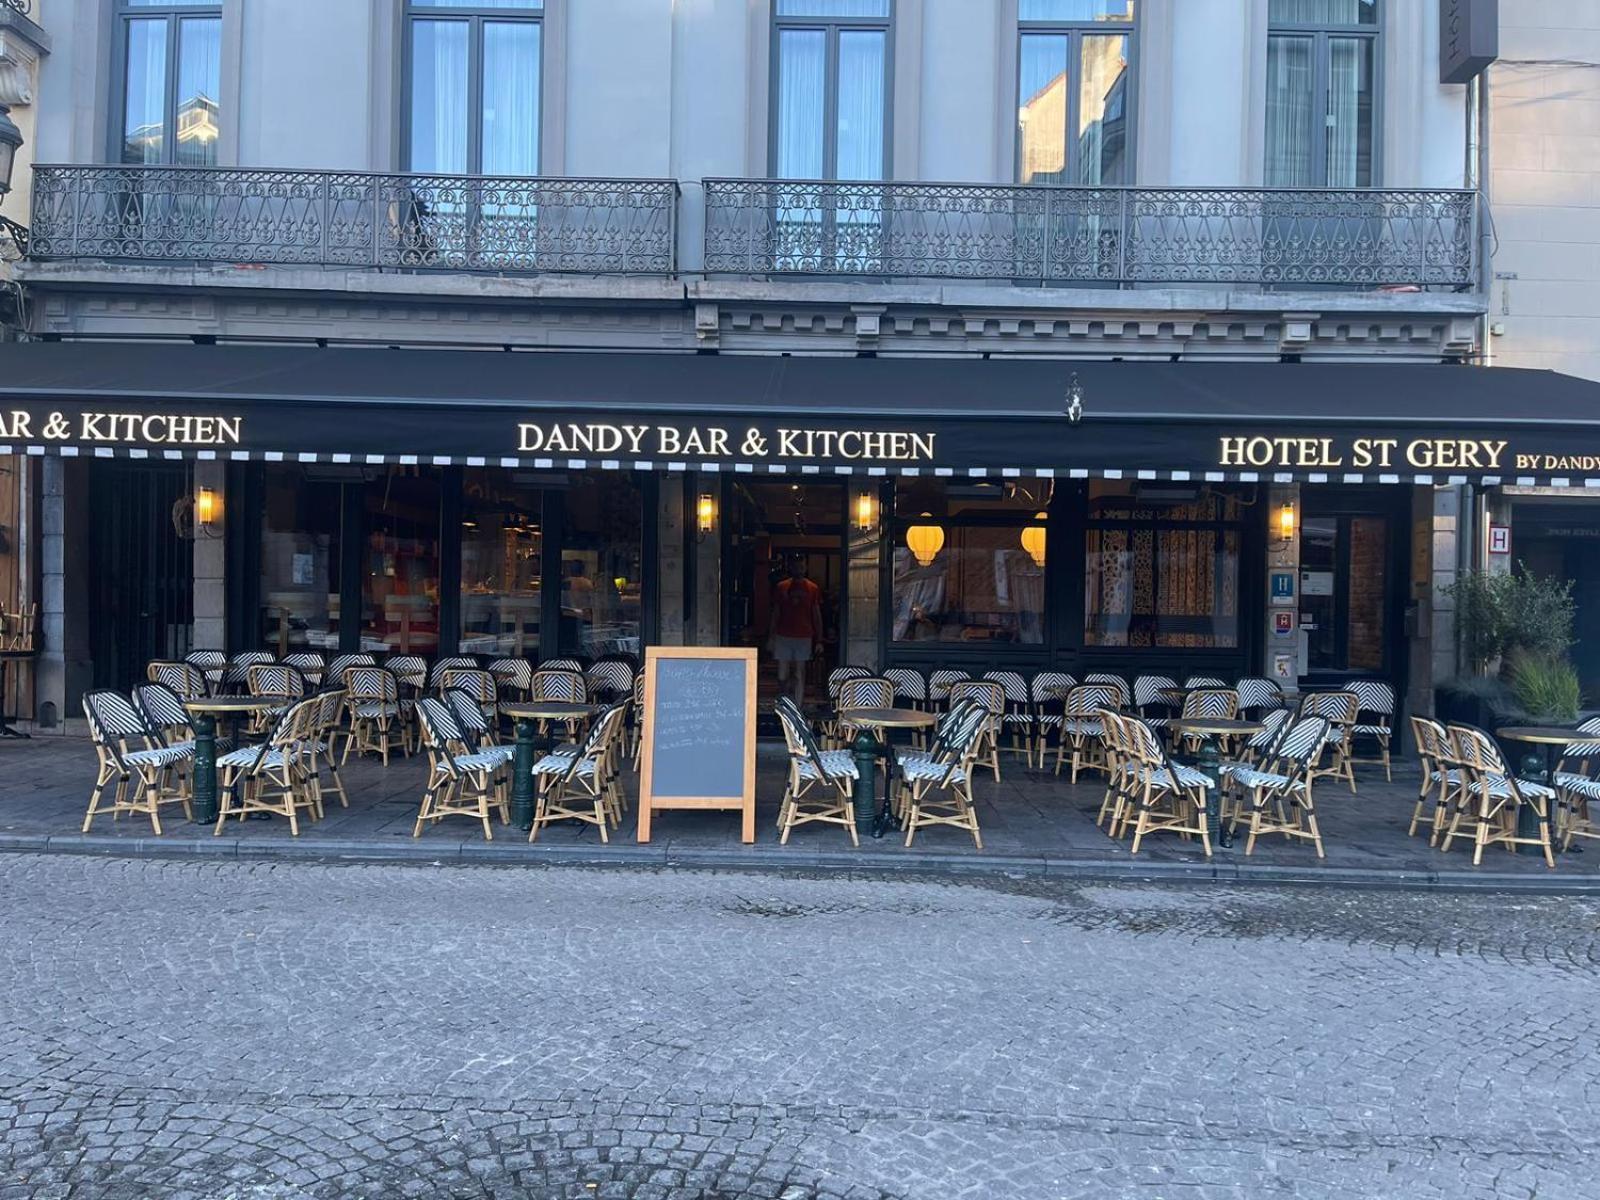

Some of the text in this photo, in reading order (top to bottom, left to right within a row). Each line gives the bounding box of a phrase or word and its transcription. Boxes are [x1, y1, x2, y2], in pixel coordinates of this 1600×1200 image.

[42, 411, 71, 440] &
[79, 412, 242, 444] KITCHEN
[517, 423, 936, 460] DANDY BAR & KITCHEN
[1218, 436, 1343, 466] HOTEL
[1352, 438, 1398, 468] ST
[1406, 439, 1508, 468] GERY
[1516, 454, 1541, 469] BY
[1493, 530, 1506, 549] H
